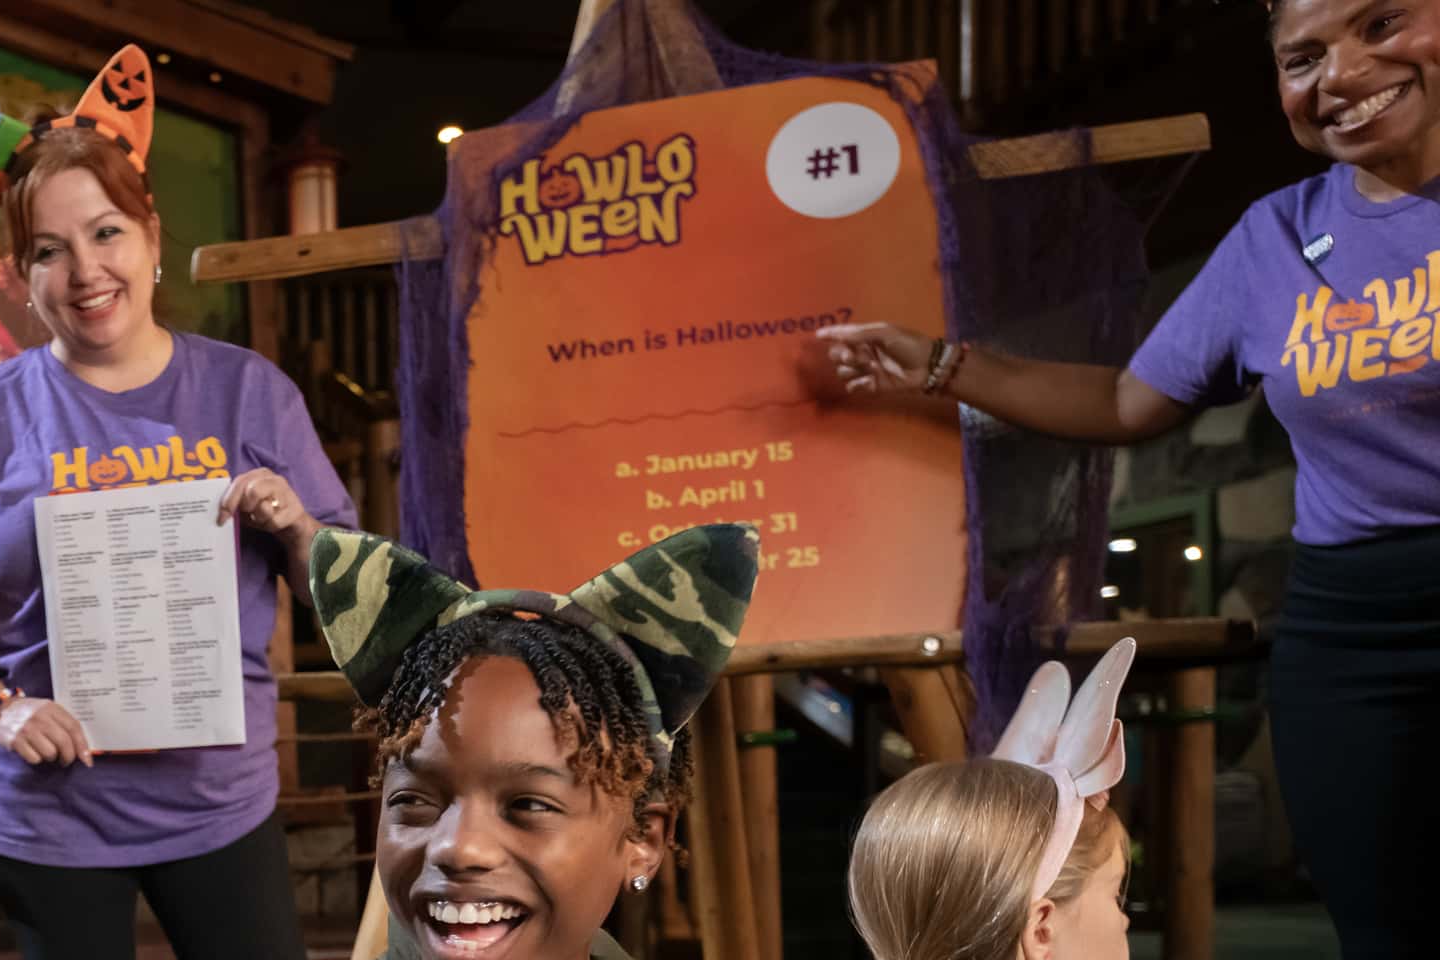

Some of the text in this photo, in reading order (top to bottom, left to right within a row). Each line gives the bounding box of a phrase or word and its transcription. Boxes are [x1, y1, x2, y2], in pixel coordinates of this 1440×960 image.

[806, 145, 860, 179] #1
[547, 307, 853, 363] When is Halloween?
[616, 442, 793, 478] a. January 15
[645, 479, 765, 510] b. April 1
[617, 530, 642, 548] c.
[769, 512, 798, 534] 31
[786, 546, 820, 568] 25
